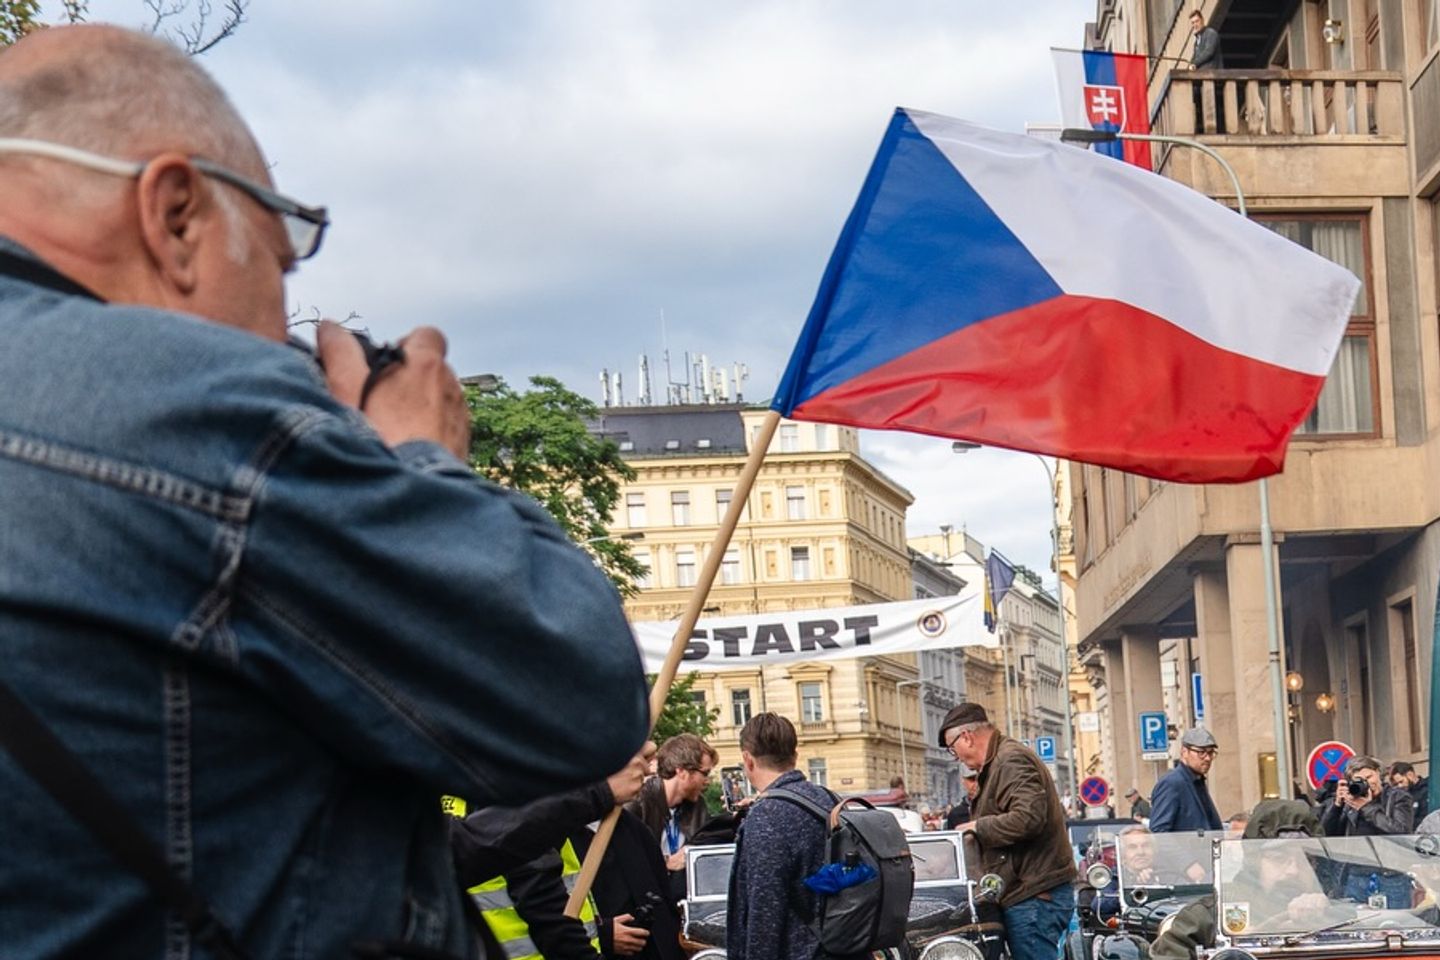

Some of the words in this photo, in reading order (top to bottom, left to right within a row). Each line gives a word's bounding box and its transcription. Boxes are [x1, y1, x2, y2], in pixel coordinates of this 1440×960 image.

[672, 615, 878, 660] START
[1145, 717, 1161, 739] P
[1039, 740, 1051, 755] P
